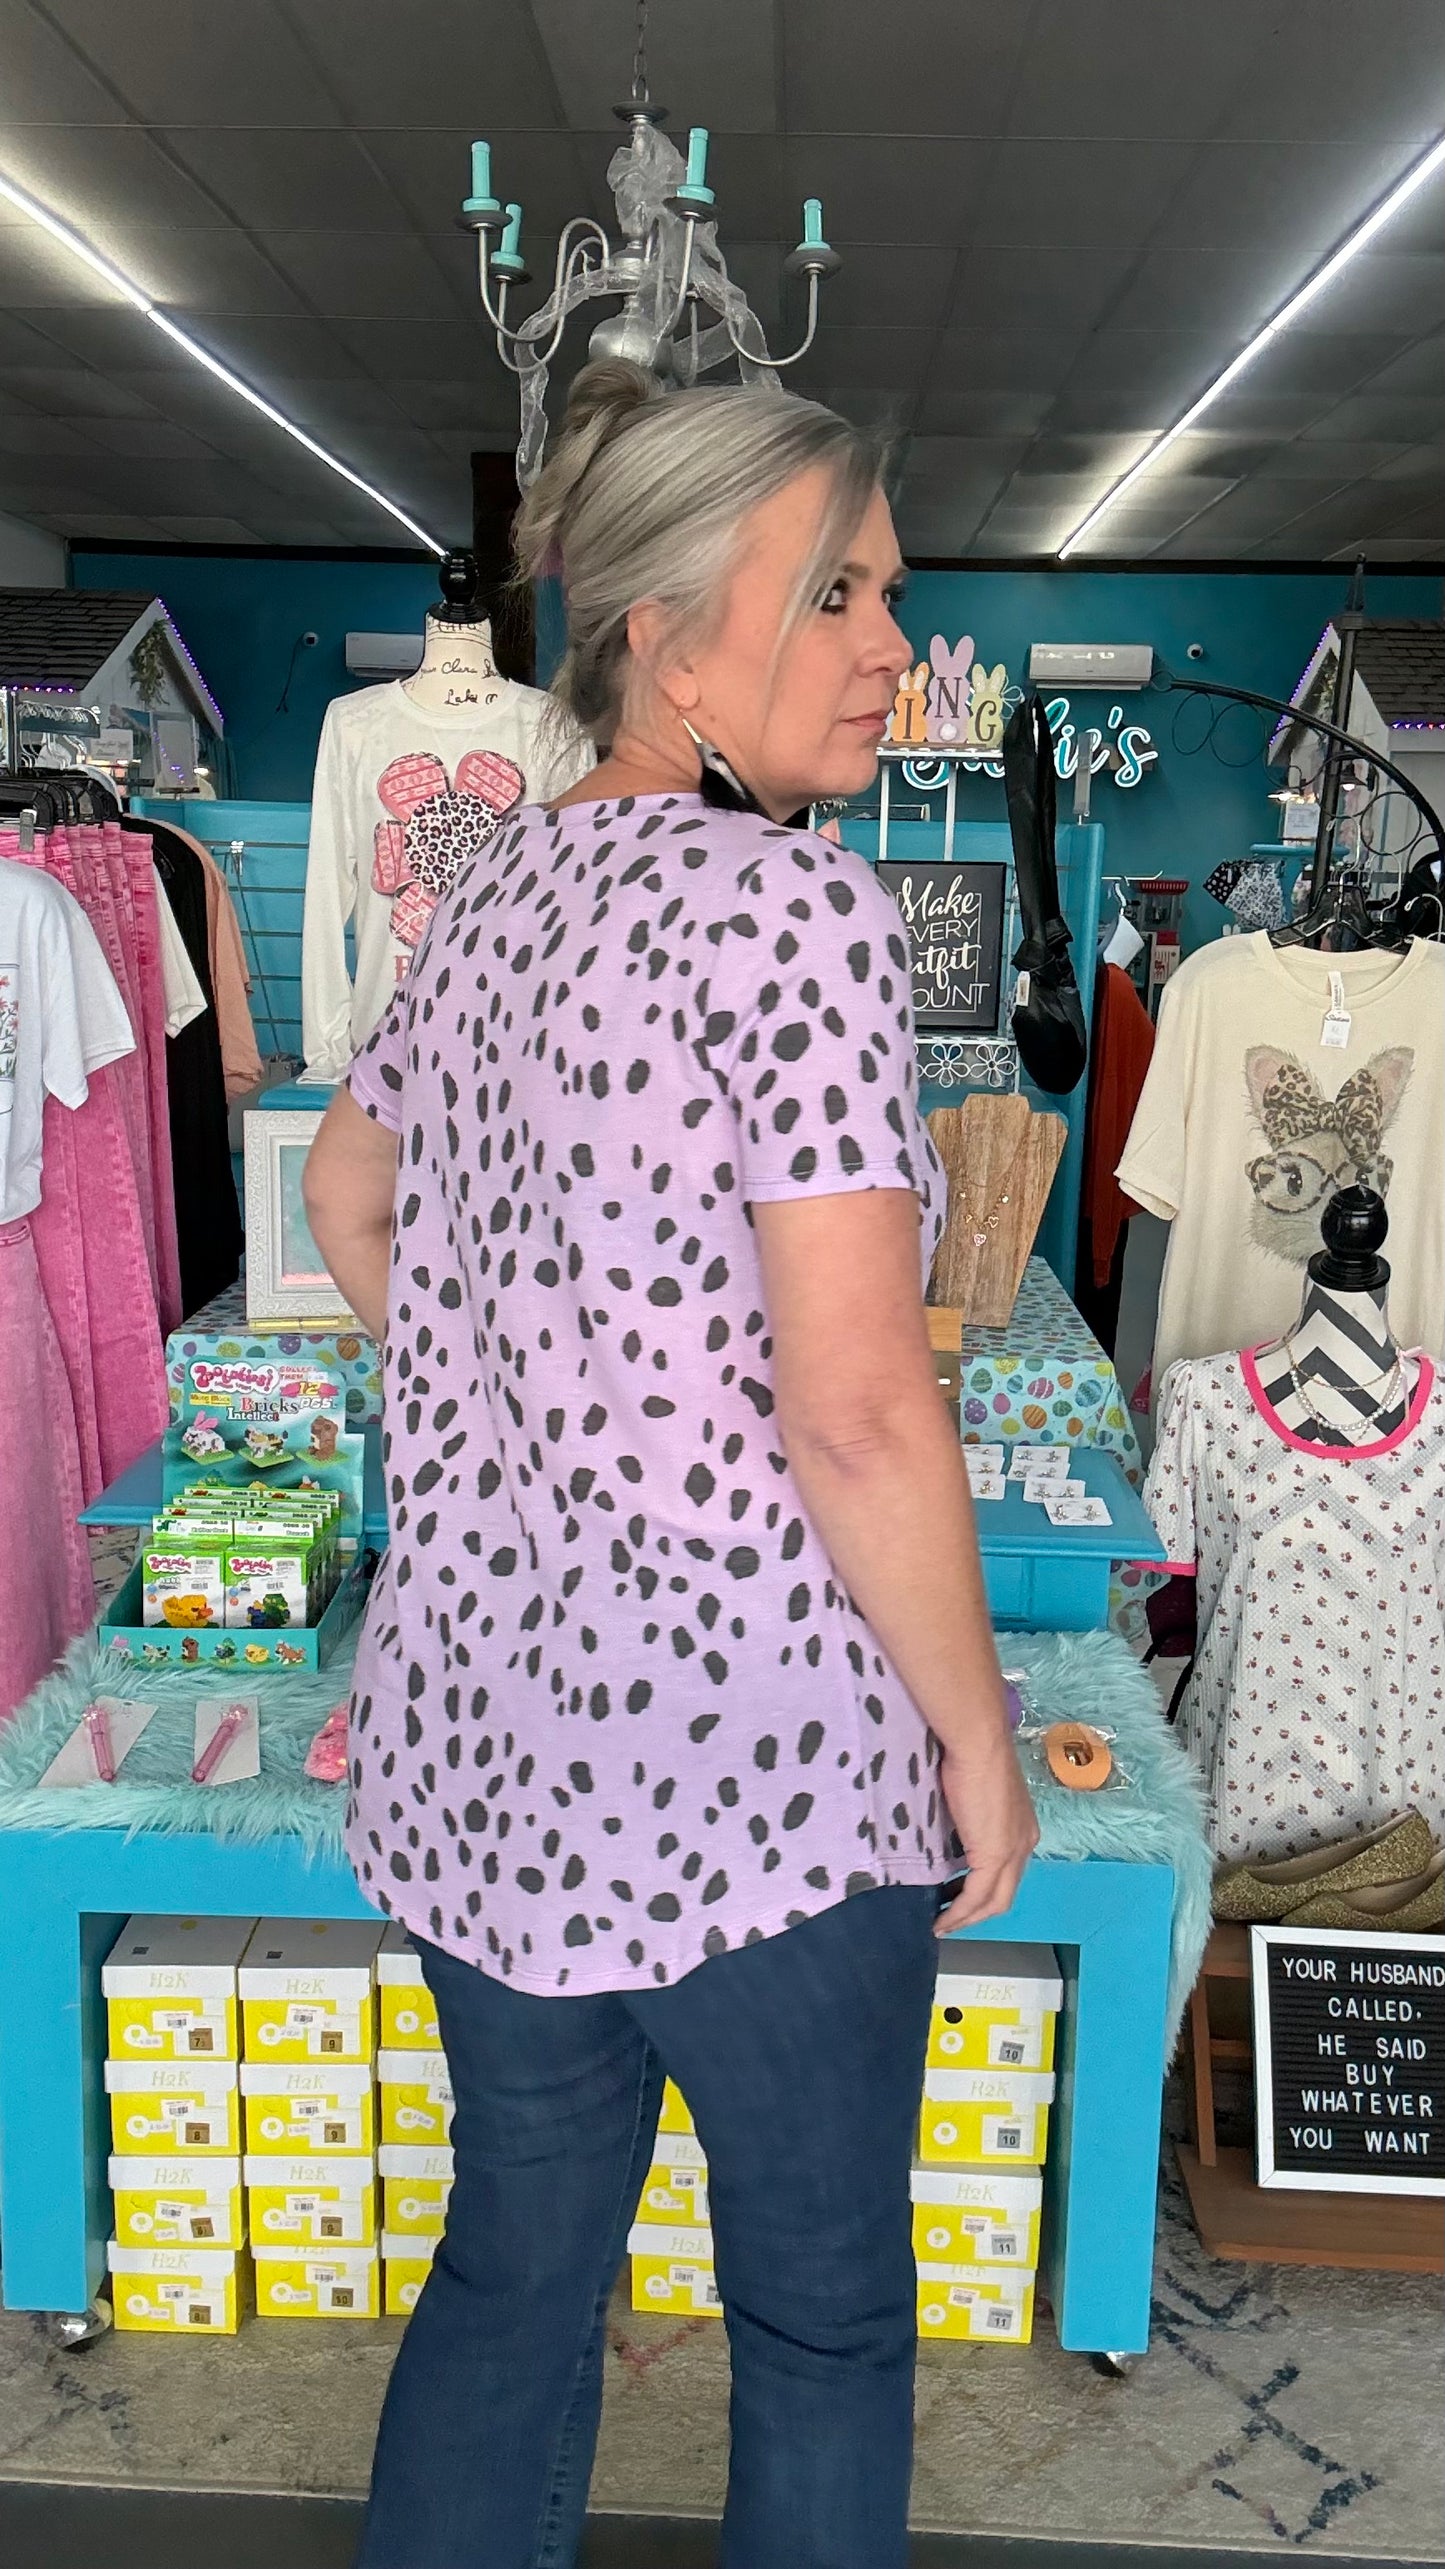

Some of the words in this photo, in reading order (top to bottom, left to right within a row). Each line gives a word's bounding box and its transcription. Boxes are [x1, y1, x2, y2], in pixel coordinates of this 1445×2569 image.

[901, 874, 980, 922] Make
[911, 983, 990, 1010] OUNT
[298, 1381, 321, 1395] 12
[228, 1406, 280, 1421] Intellect
[241, 1397, 299, 1414] Bricks
[150, 1971, 189, 1988] H2K
[1282, 1957, 1337, 1982] YOUR
[1350, 1962, 1445, 1987] HUSBAND
[285, 1978, 326, 1994] H2K
[975, 1983, 1016, 2000] H2K
[1328, 1997, 1422, 2022] CALLED.
[329, 2039, 335, 2049] 9
[1318, 2034, 1347, 2056] HE
[1376, 2038, 1427, 2060] SAID
[1005, 2049, 1018, 2061] 10
[423, 2061, 446, 2078] H2
[1346, 2063, 1394, 2087] BUY
[152, 2071, 191, 2087] H2K
[286, 2073, 326, 2090] H2K
[971, 2080, 1010, 2098] H2K
[1301, 2089, 1433, 2117] WHATEVER
[1003, 2135, 1016, 2146] 10
[1289, 2127, 1333, 2150] YOU
[1364, 2130, 1430, 2155] WANT
[290, 2165, 328, 2181] H2K
[424, 2157, 449, 2174] H2
[153, 2167, 193, 2184] H2K
[956, 2183, 997, 2201] H2K
[672, 2237, 707, 2254] H2K
[999, 2244, 1010, 2254] 11
[152, 2254, 190, 2270] H2K
[994, 2317, 1006, 2328] 11
